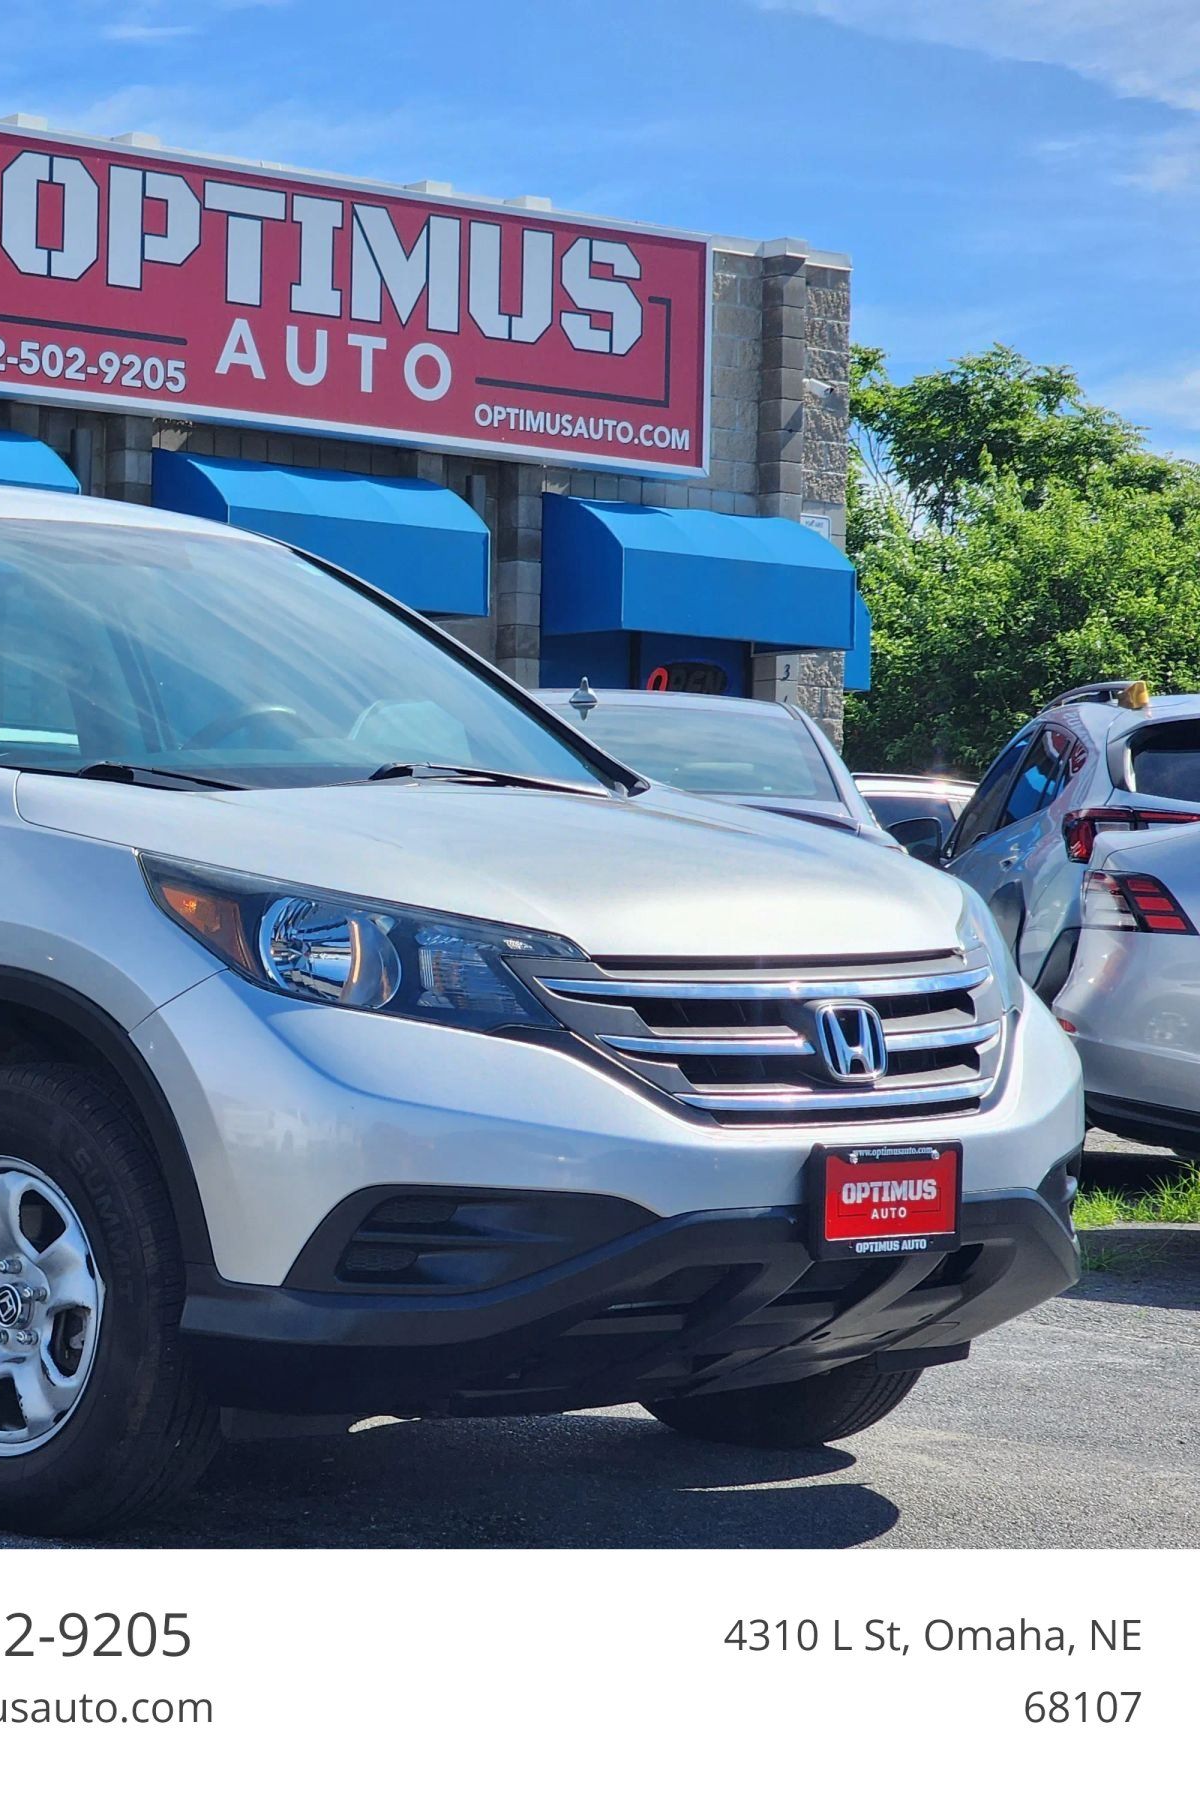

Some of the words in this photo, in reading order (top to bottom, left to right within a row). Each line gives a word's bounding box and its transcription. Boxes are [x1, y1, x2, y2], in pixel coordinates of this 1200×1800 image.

[1, 151, 643, 355] OPTIMUS
[216, 318, 452, 400] AUTO
[475, 403, 690, 451] OPTIMUSAUTO.COM
[842, 1179, 937, 1205] OPTIMUS
[871, 1207, 908, 1220] AUTO
[855, 1241, 900, 1254] OPTIMUS
[902, 1239, 927, 1251] AUTO
